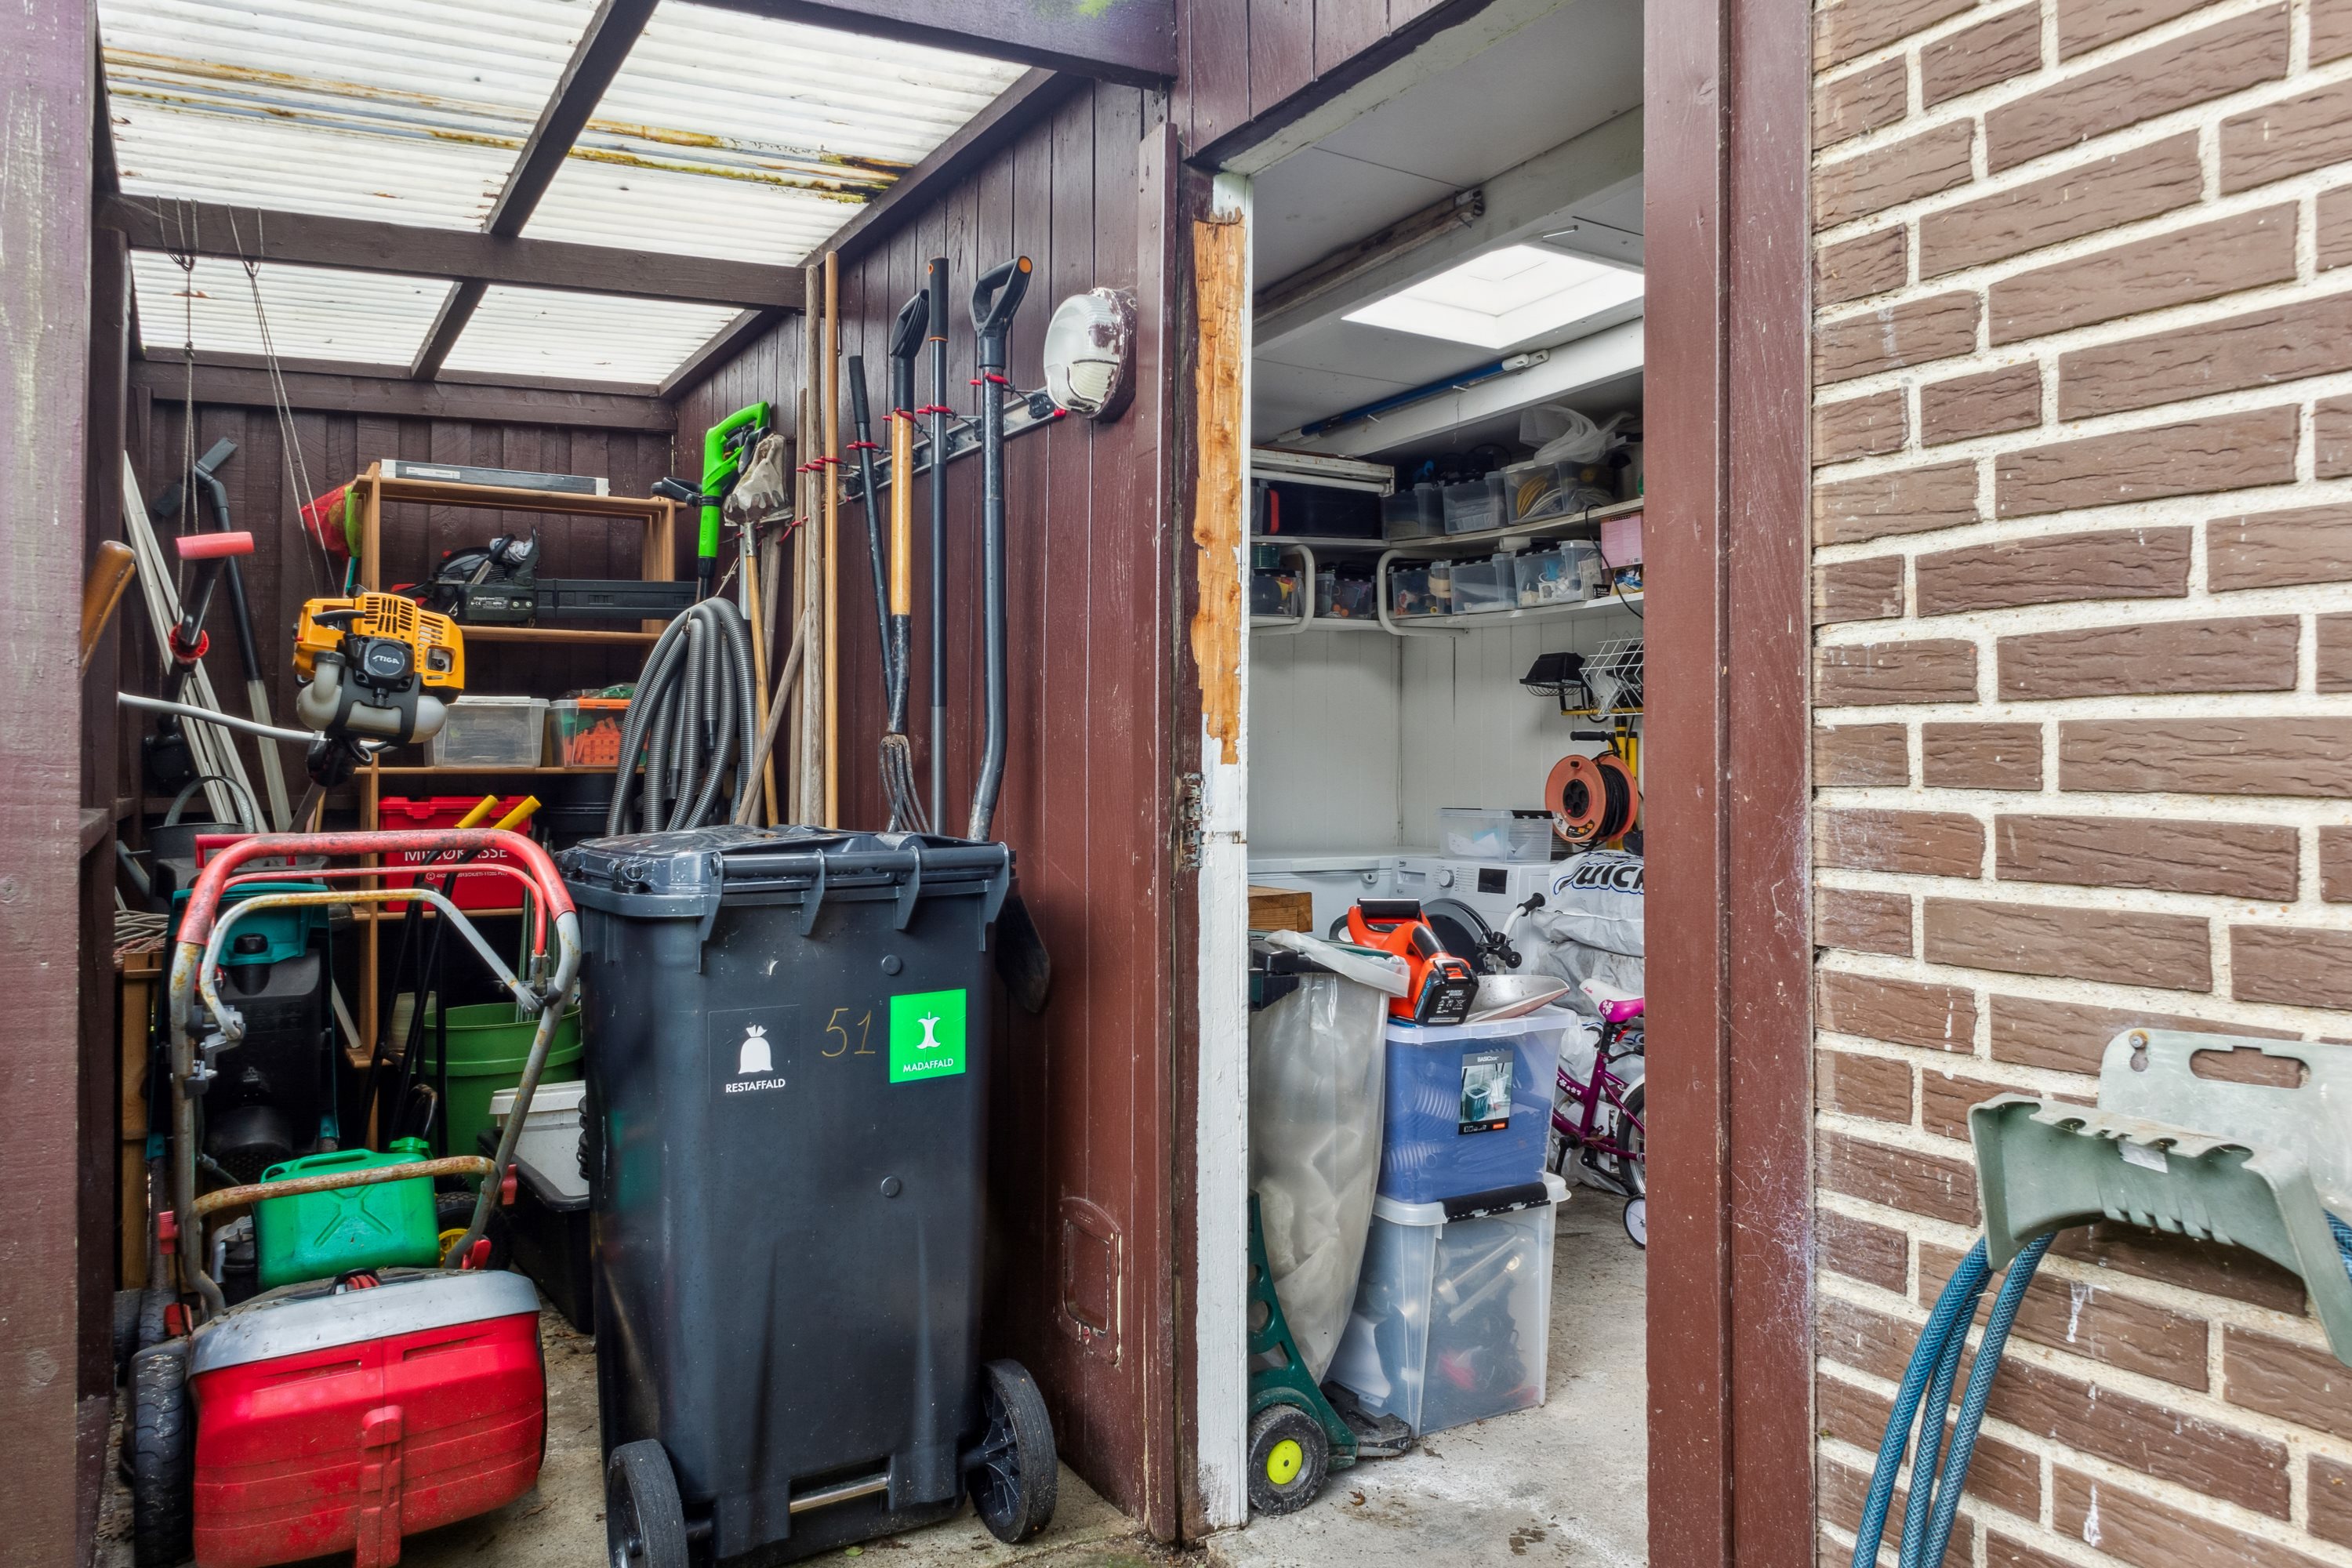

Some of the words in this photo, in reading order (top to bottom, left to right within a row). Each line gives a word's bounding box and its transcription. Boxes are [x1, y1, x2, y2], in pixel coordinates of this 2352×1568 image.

[372, 655, 400, 664] STIGA
[822, 1007, 876, 1057] 51
[902, 1058, 954, 1073] MADAFFALD
[725, 1078, 786, 1094] RESTAFFALD
